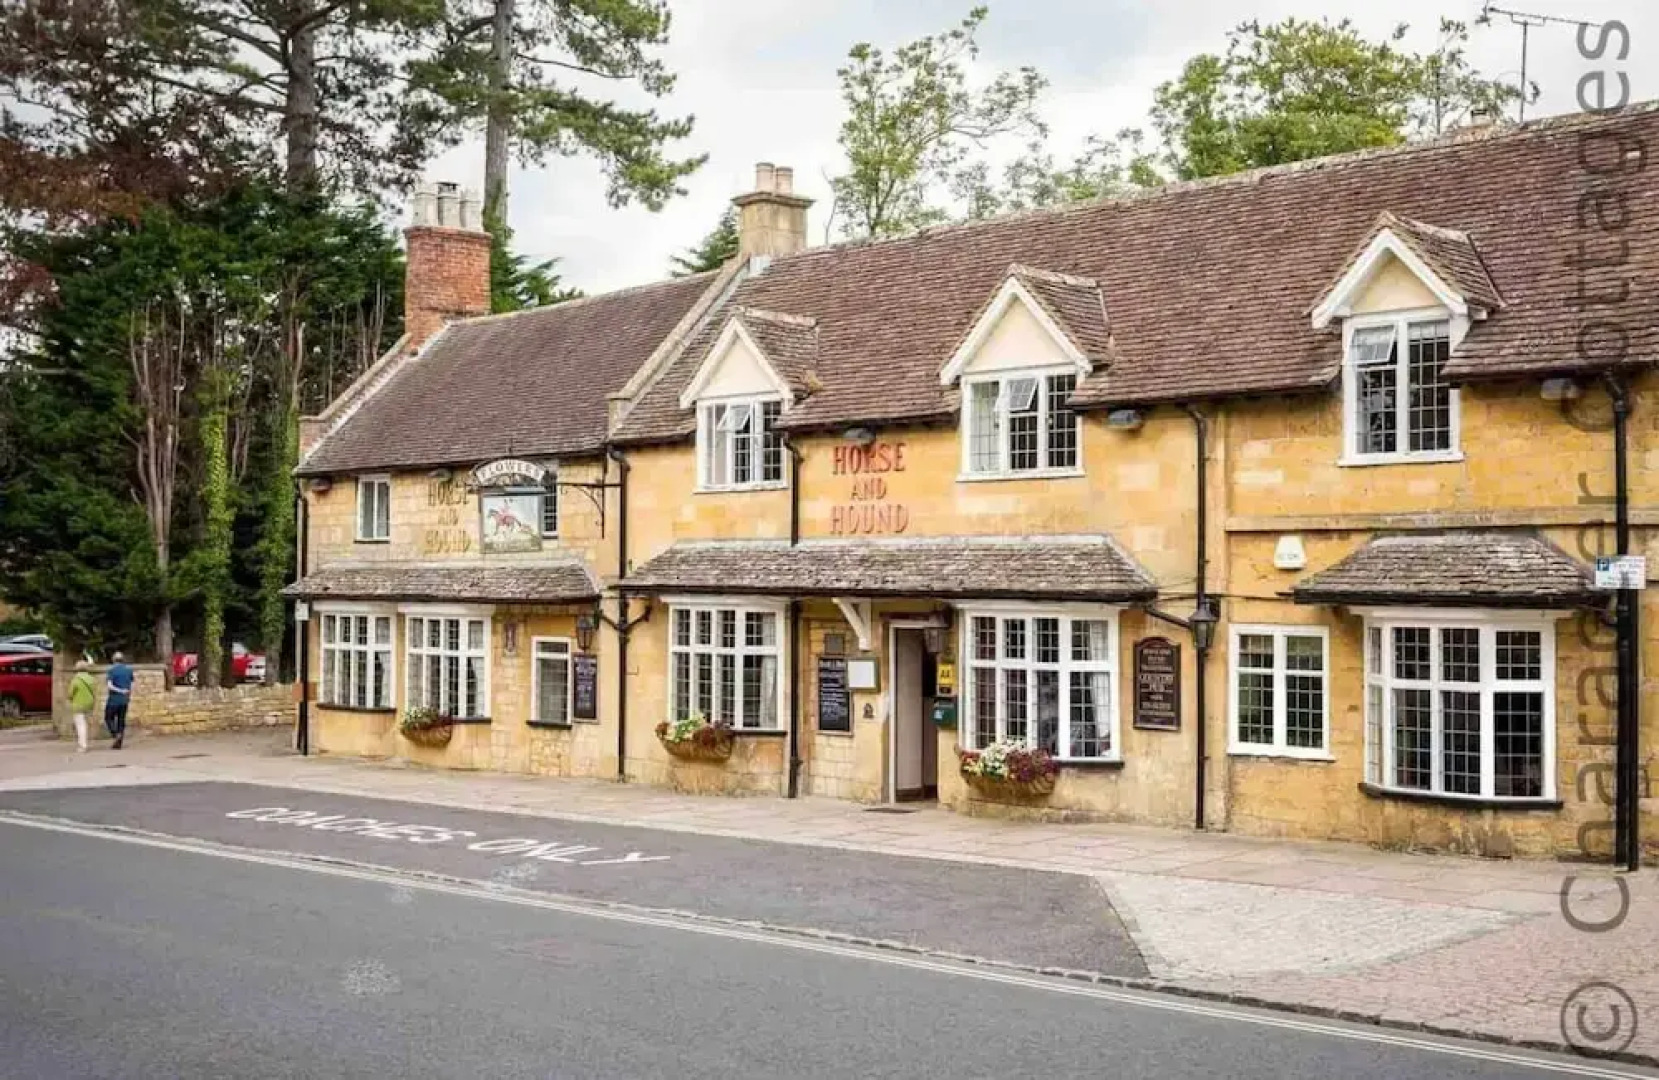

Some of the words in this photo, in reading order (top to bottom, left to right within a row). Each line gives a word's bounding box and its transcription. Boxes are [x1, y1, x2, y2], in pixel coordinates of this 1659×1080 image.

[832, 442, 906, 475] HORSE
[850, 477, 887, 500] AND
[830, 503, 909, 536] HOUND
[225, 806, 477, 845] COACHES
[466, 837, 671, 866] ONLY
